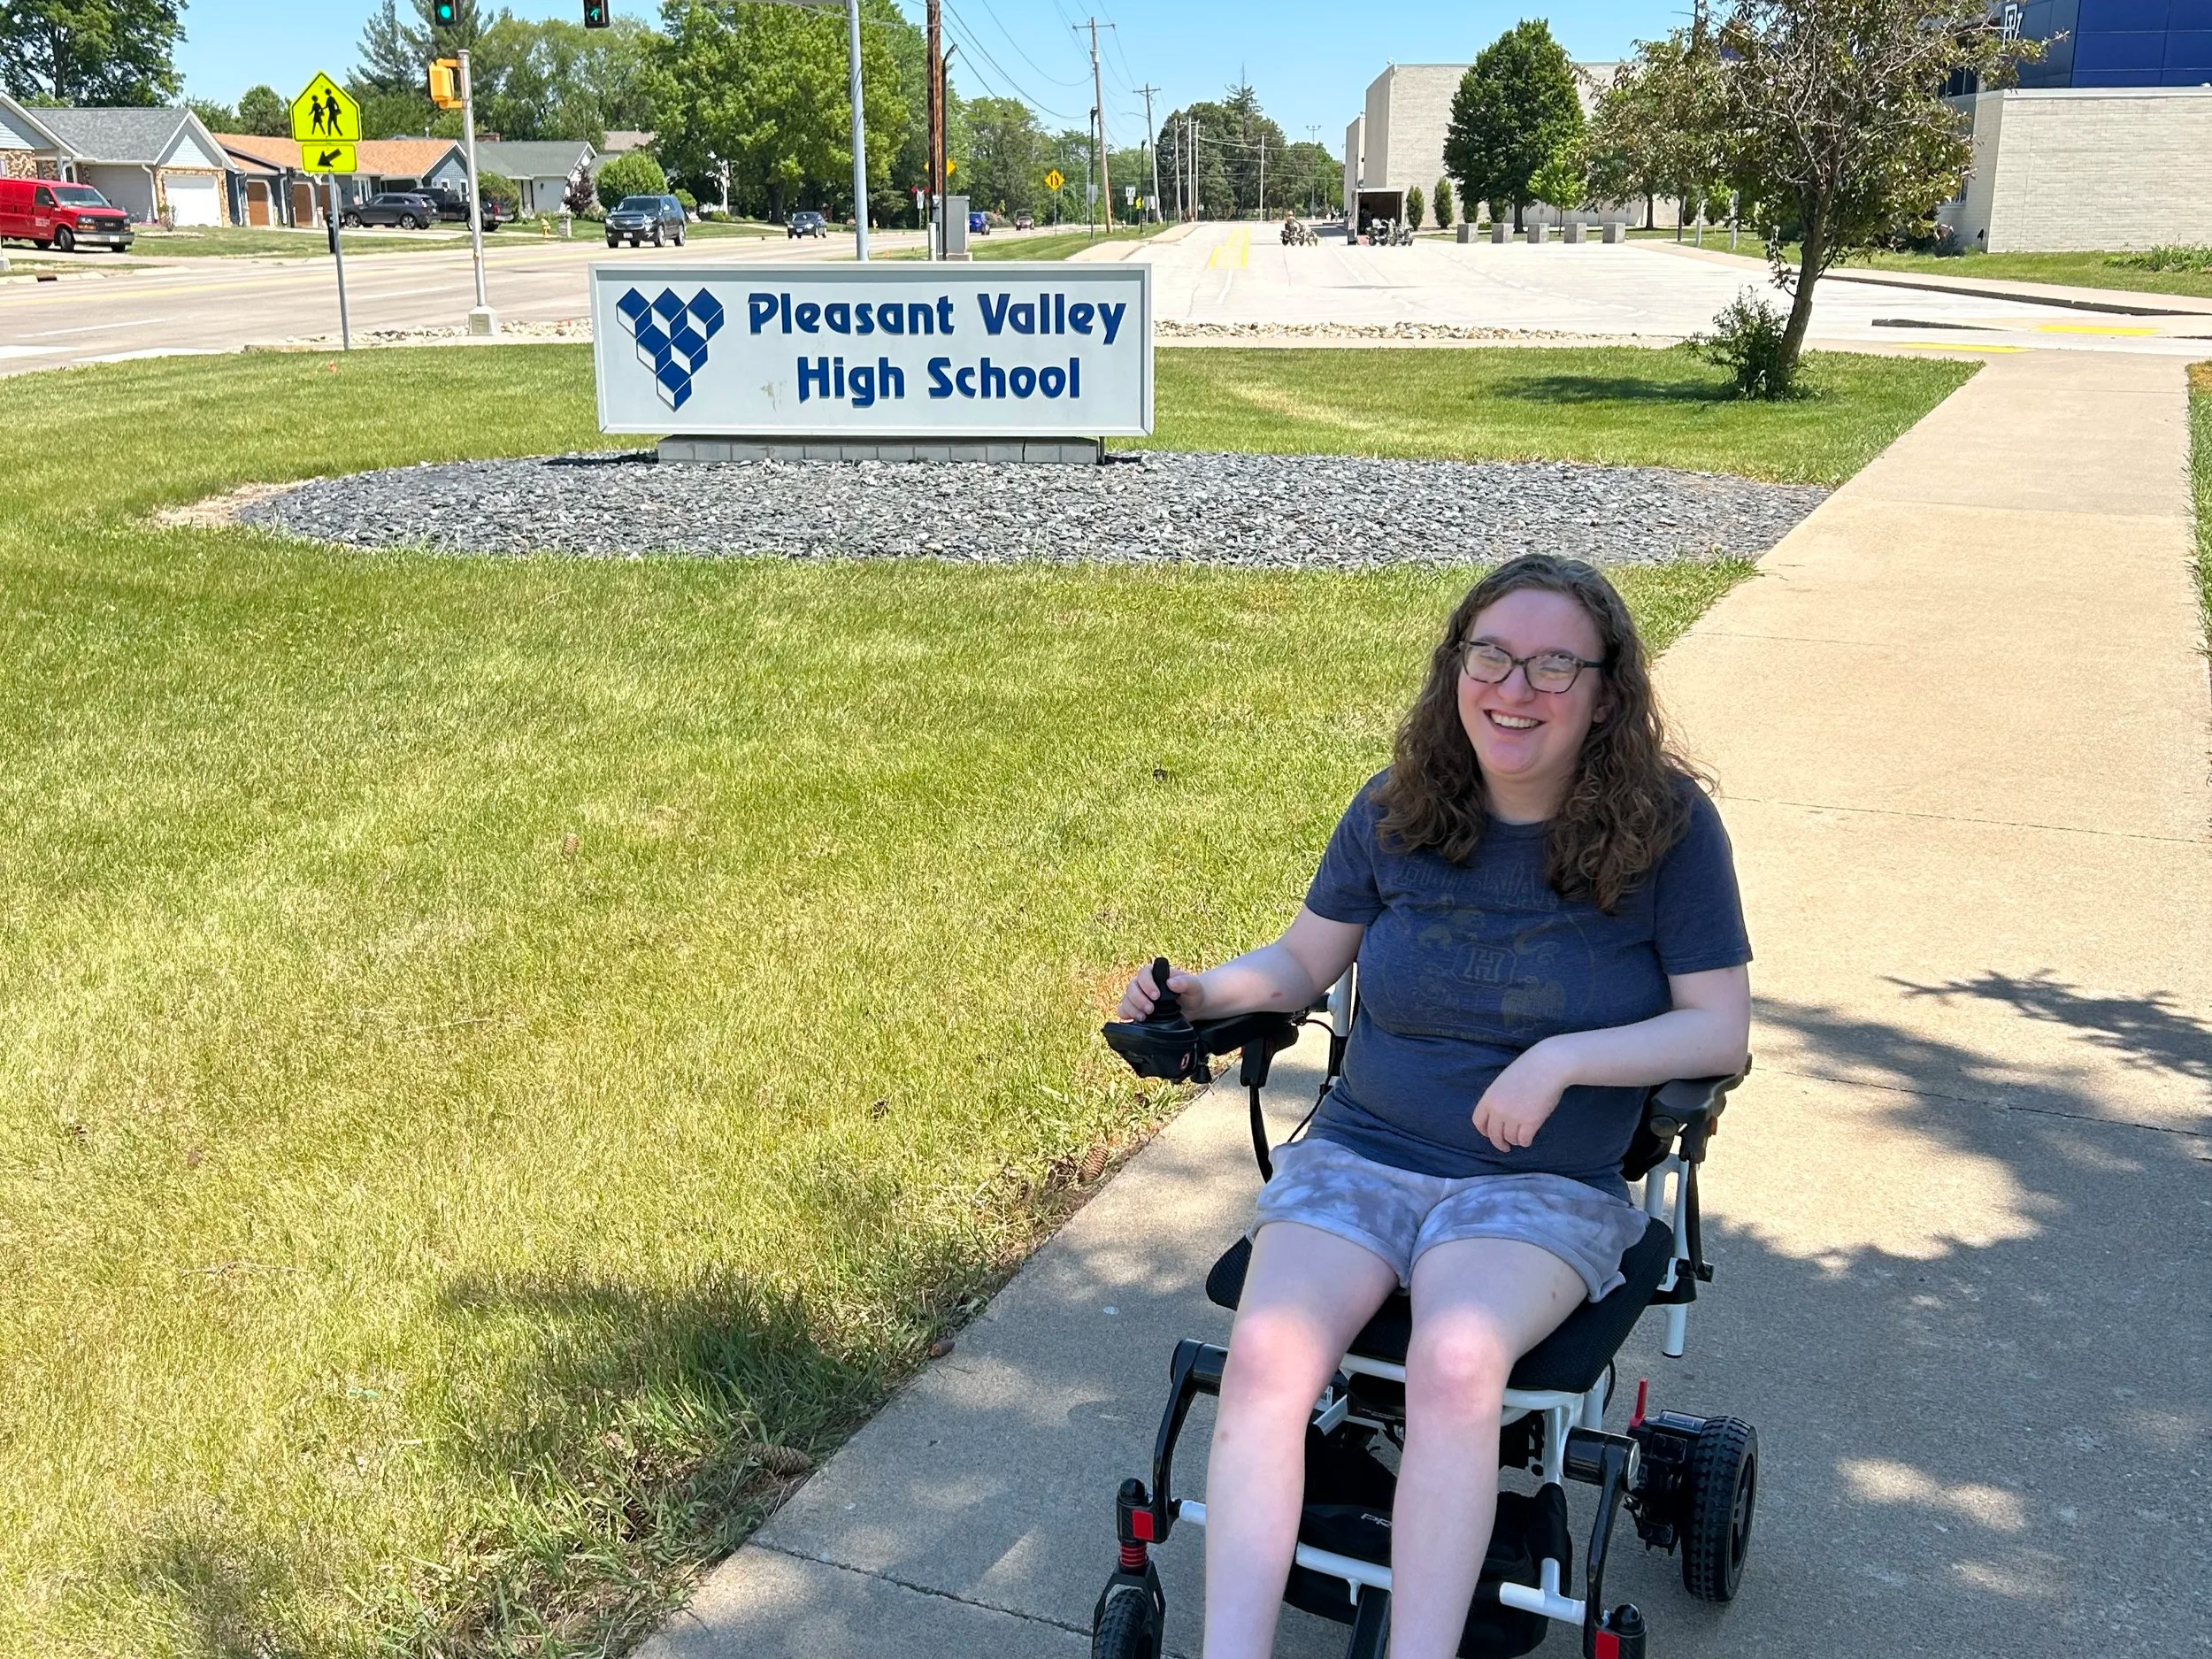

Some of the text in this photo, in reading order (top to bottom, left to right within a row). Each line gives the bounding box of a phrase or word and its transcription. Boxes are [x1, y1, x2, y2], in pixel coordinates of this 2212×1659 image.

[749, 293, 1126, 344] Pleasant Valley
[797, 357, 1080, 407] High School
[1463, 945, 1506, 983] H
